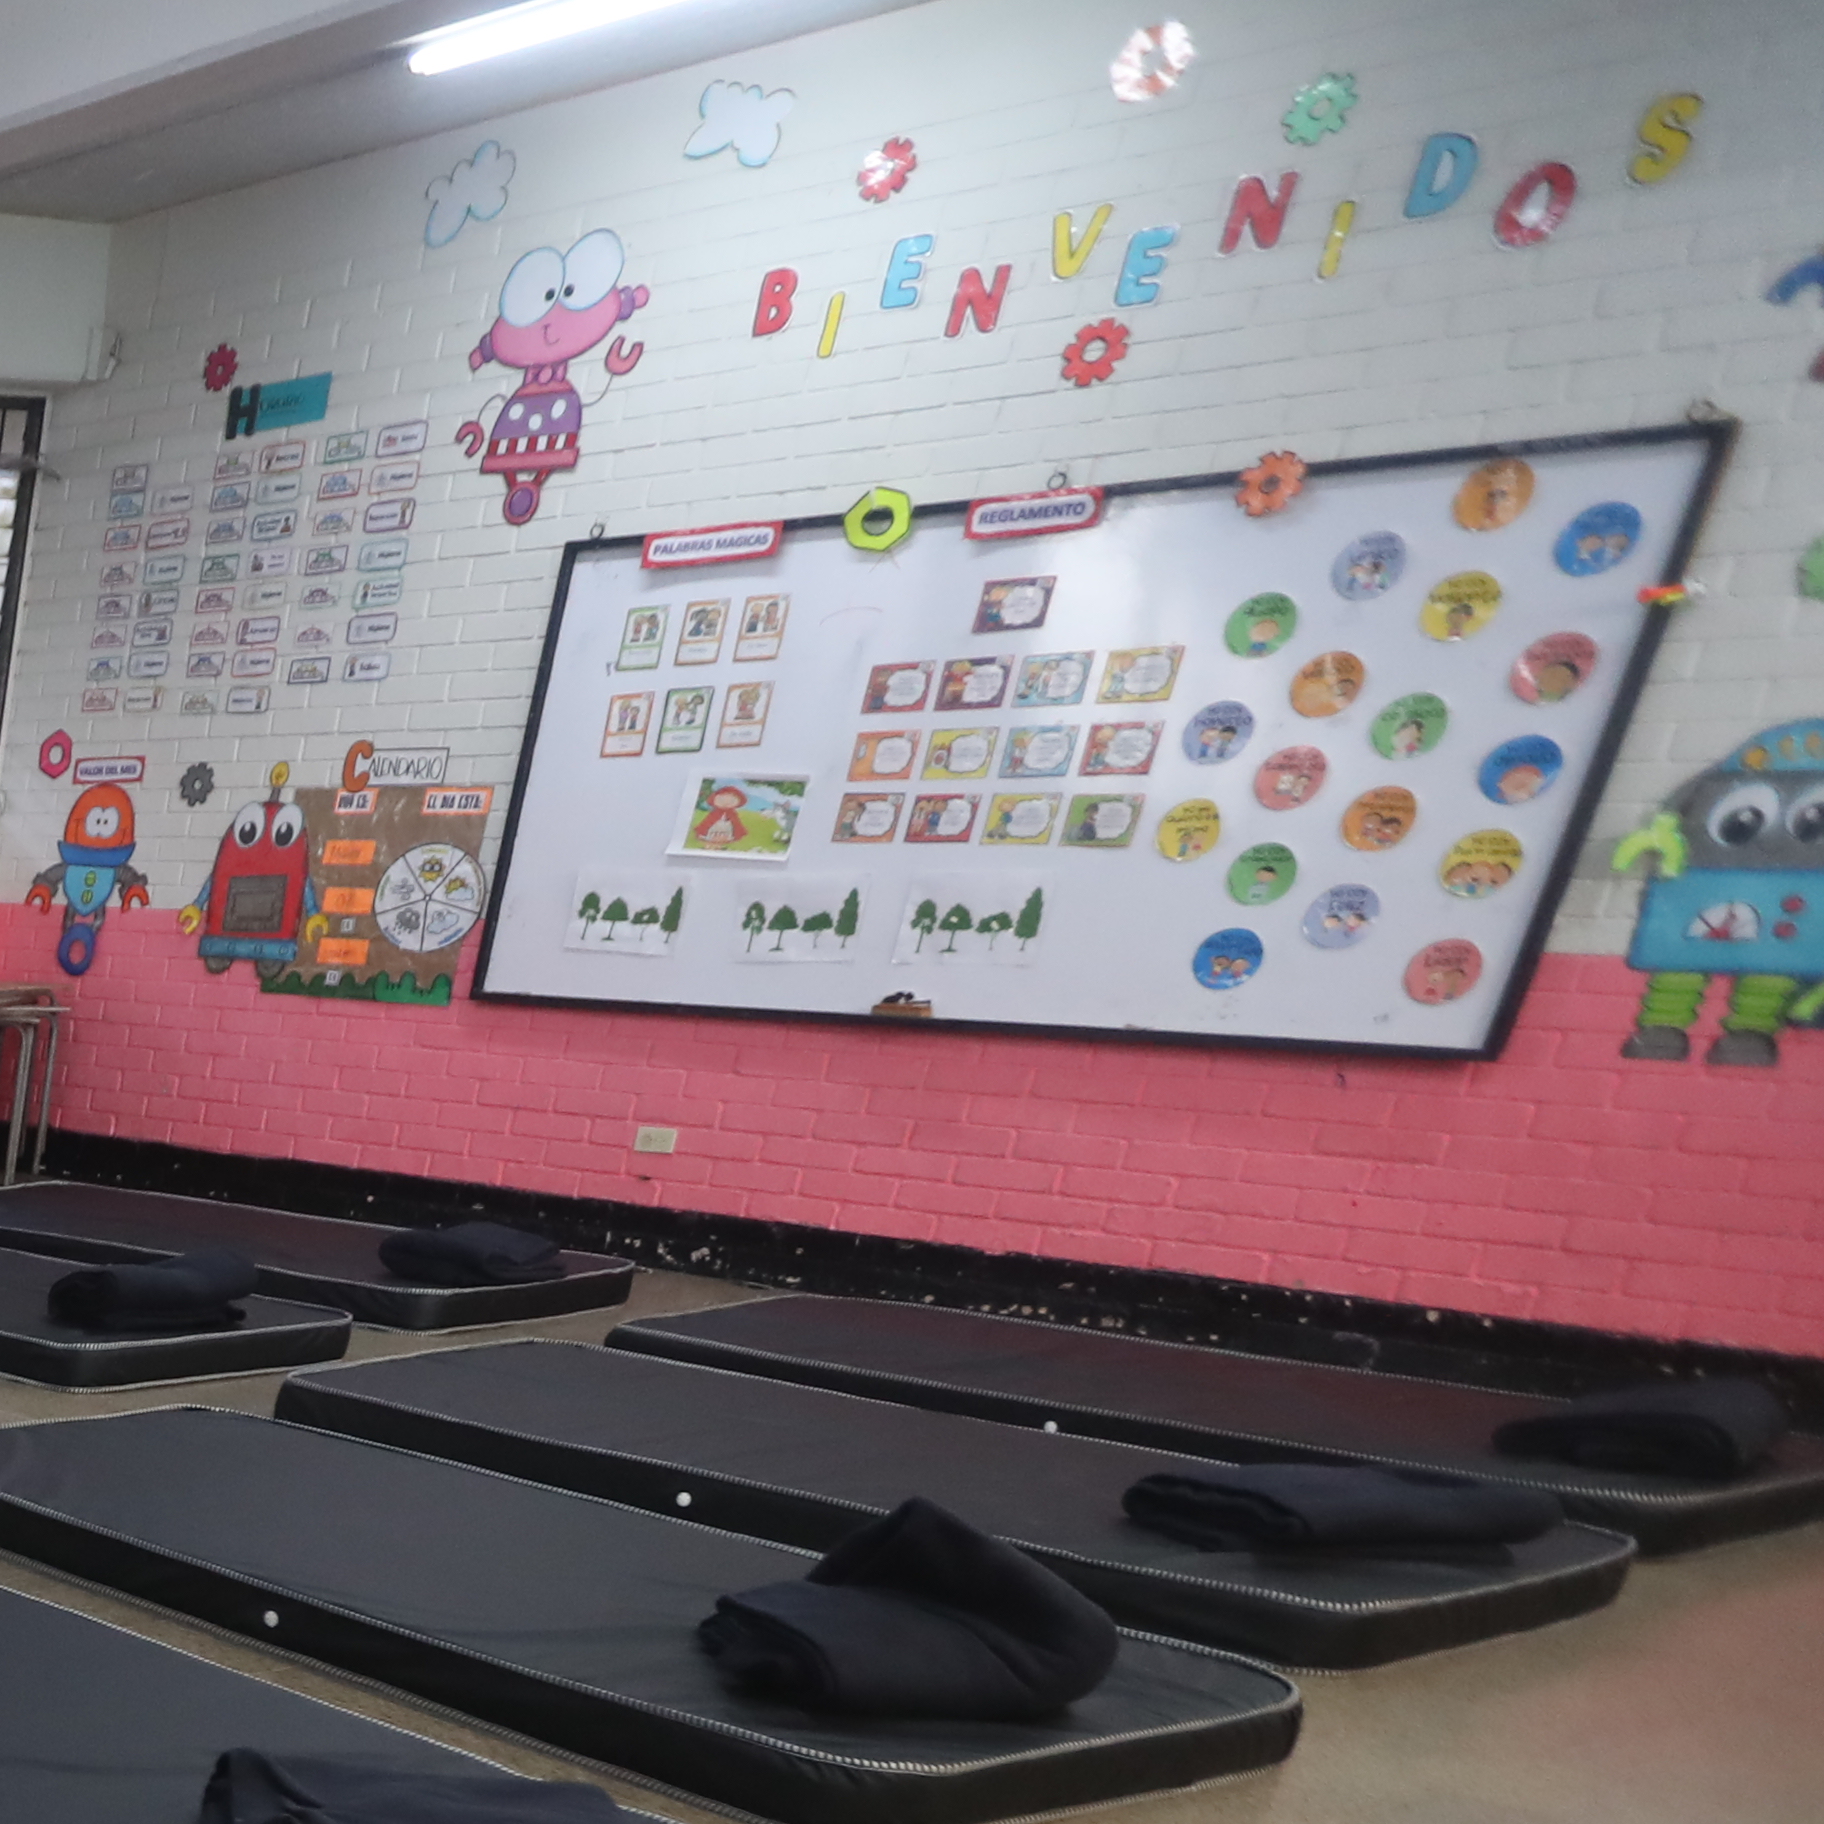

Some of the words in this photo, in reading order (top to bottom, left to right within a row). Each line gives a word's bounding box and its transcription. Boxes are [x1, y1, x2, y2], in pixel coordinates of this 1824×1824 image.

[751, 90, 1706, 360] BIENVENIDOS
[978, 502, 1086, 525] REGLAMENTO
[653, 539, 713, 557] PALABRAS
[715, 532, 770, 550] MAGICAS
[80, 766, 104, 776] VALOR
[105, 765, 118, 775] DEL
[342, 739, 444, 792] CALENDARIO
